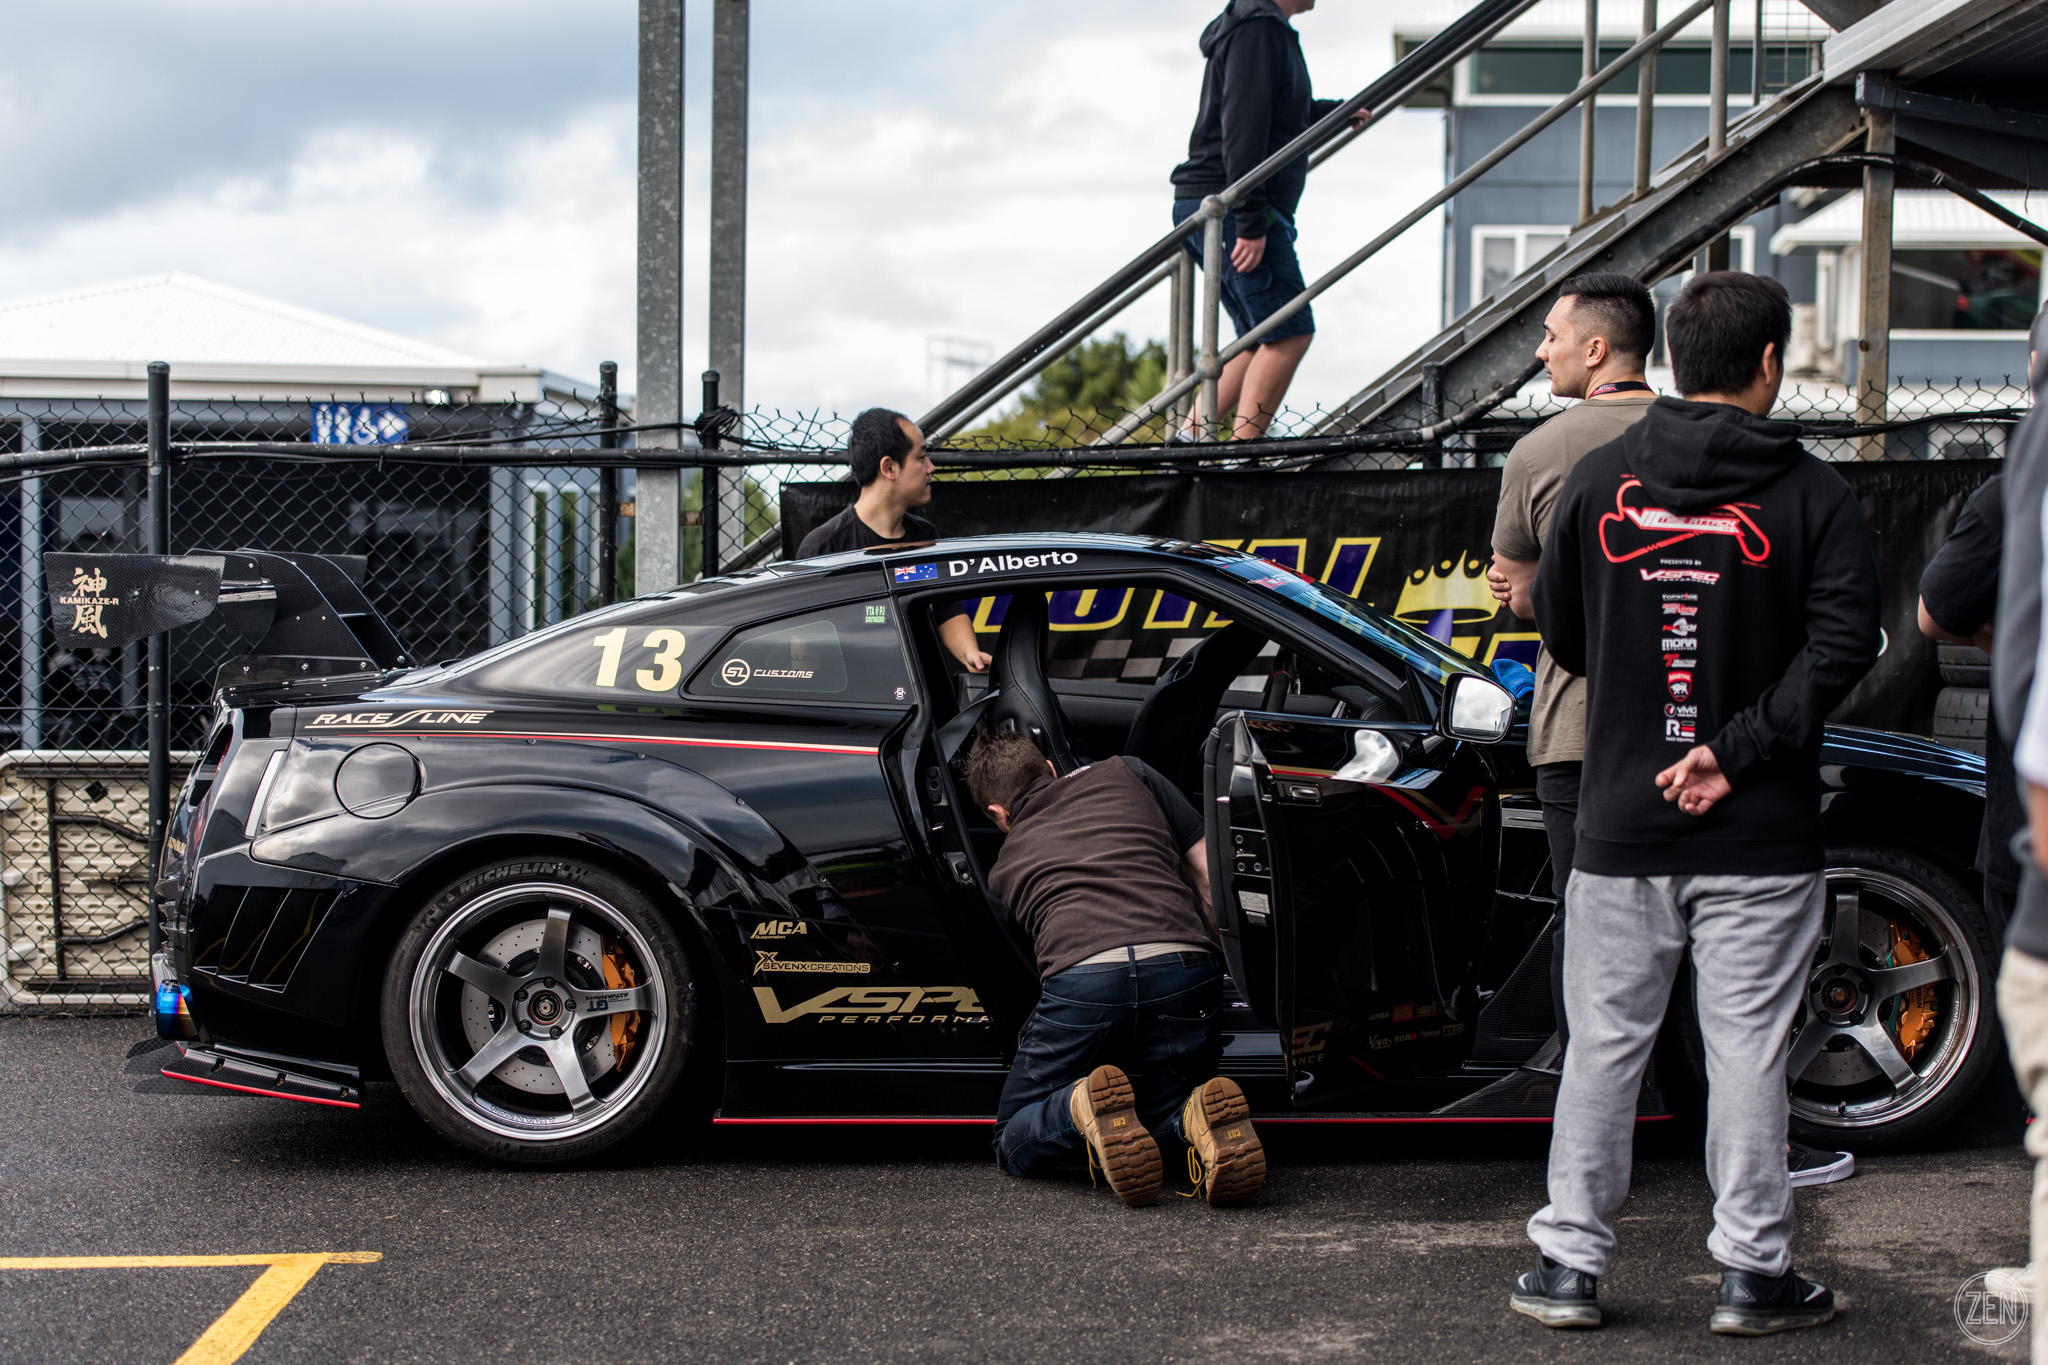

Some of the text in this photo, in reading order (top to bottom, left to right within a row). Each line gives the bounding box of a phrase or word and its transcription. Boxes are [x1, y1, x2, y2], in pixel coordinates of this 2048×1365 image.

[1688, 517, 1736, 527] ATTACK
[948, 551, 1078, 577] D'Alberto
[71, 567, 108, 597] 神
[59, 596, 119, 605] KAMIKAZE-R
[70, 604, 108, 639] 風
[592, 627, 686, 692] 13
[753, 669, 814, 679] CUSTOMS
[312, 712, 488, 725] RACE LINE
[459, 861, 556, 894] MICHELIN
[750, 919, 807, 939] MCA
[586, 1000, 609, 1012] GT
[1112, 1116, 1127, 1128] CAT
[1227, 1128, 1242, 1140] CAT
